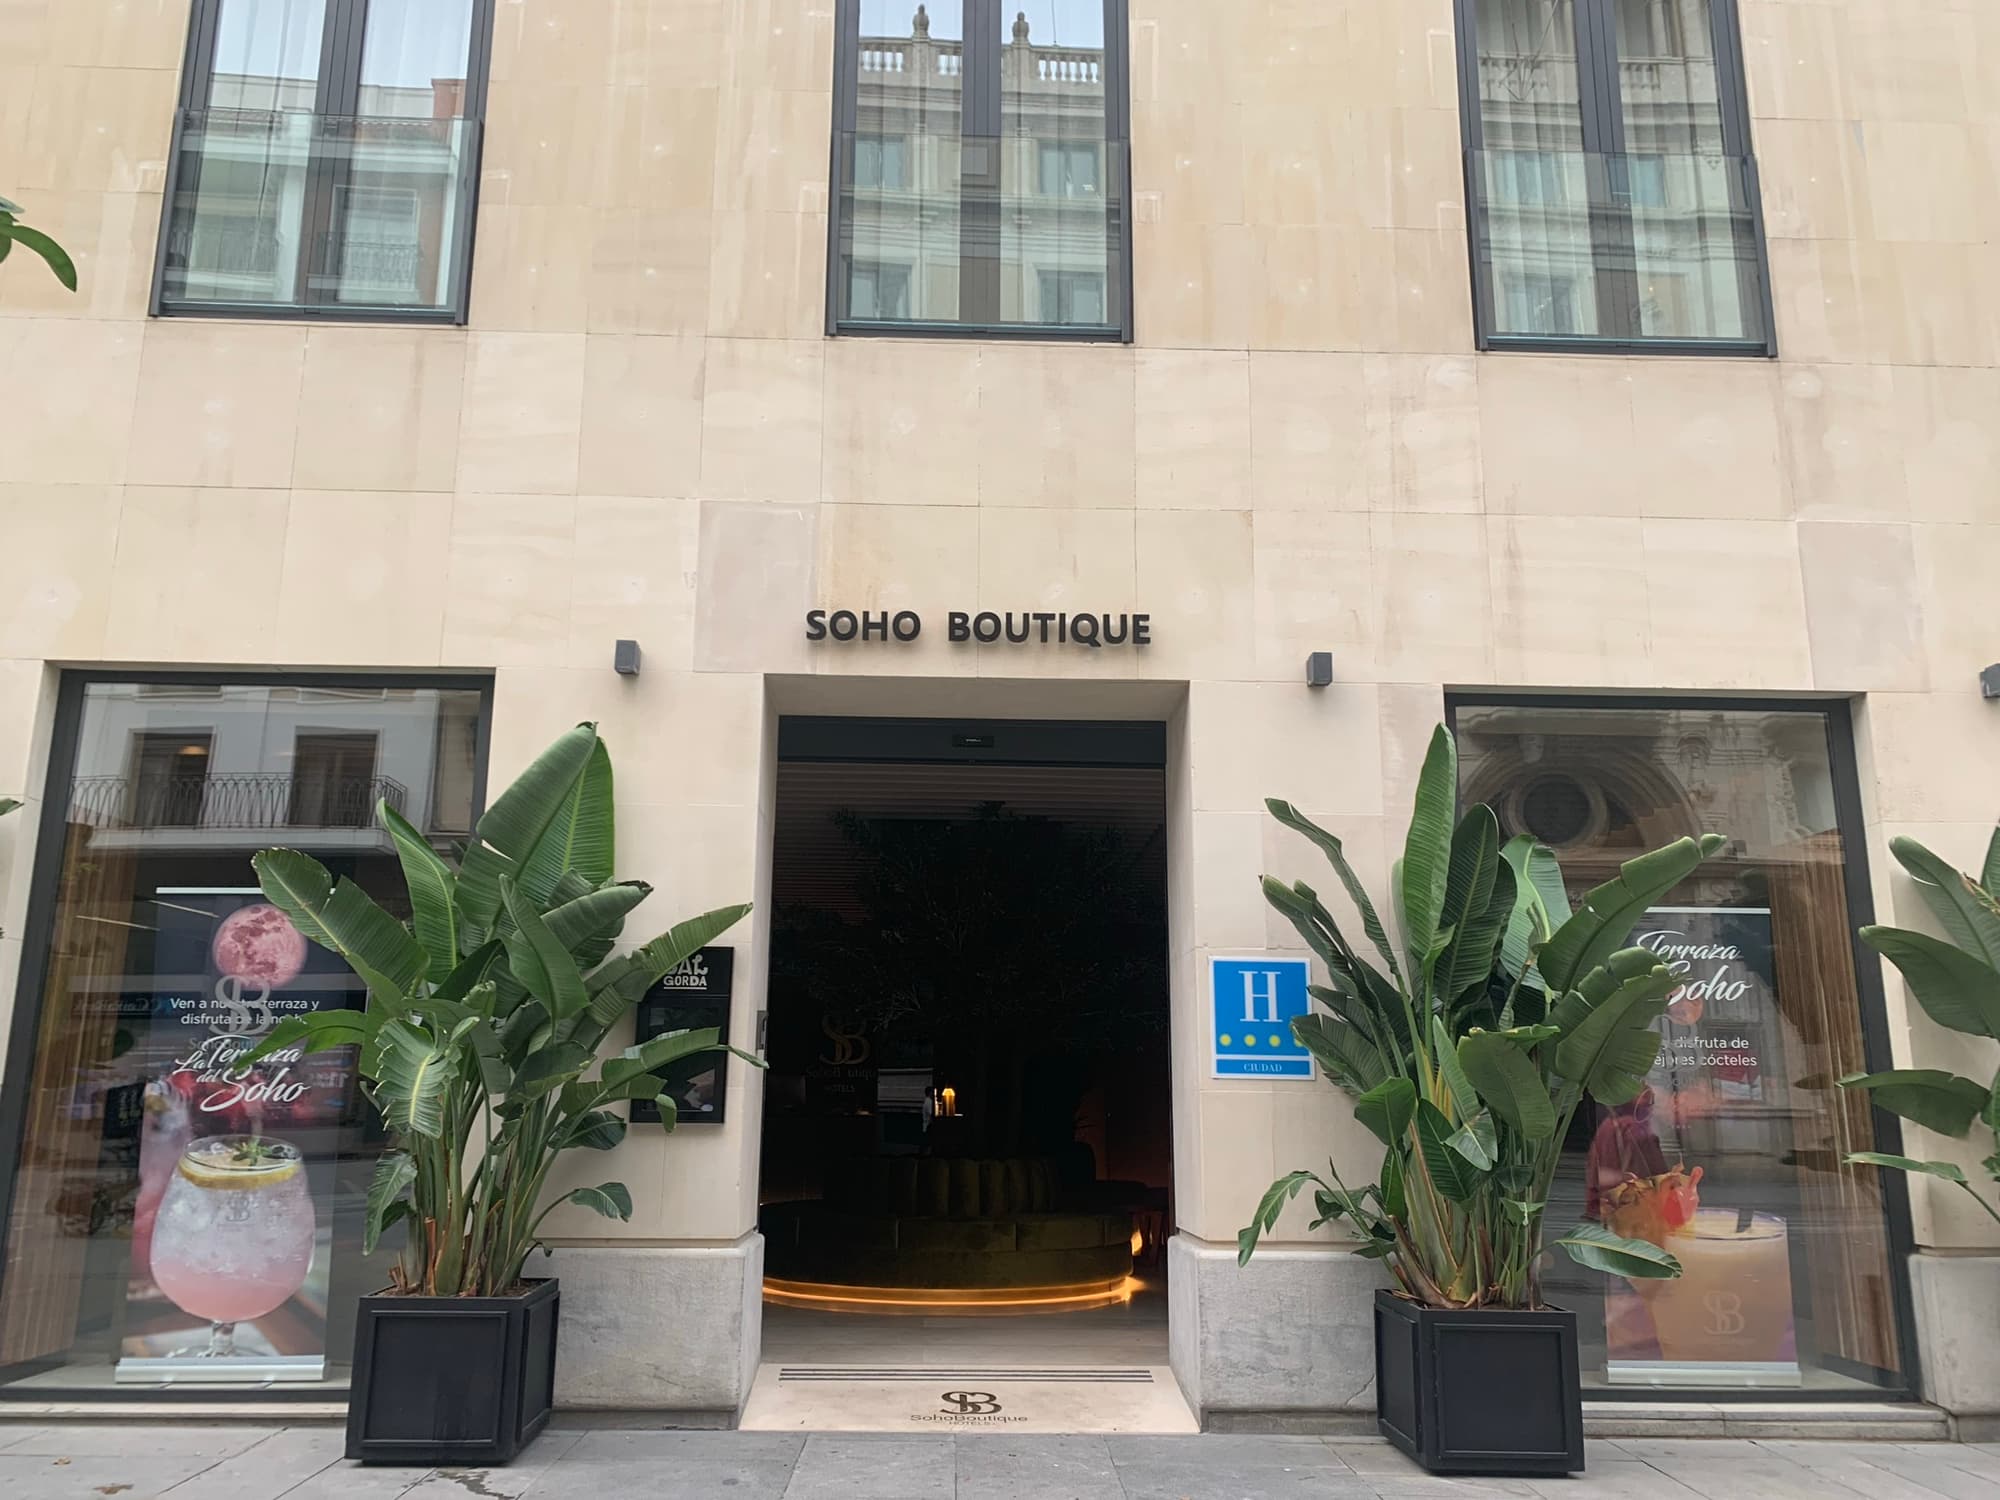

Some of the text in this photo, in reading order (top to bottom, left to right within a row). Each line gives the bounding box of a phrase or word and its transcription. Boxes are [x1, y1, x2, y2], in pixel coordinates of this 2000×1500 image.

[806, 610, 1152, 647] SOHO BOUTIQUE
[1637, 930, 1743, 960] Terraza
[667, 954, 709, 975] AL
[663, 975, 708, 986] GORDA
[1238, 970, 1284, 1023] H
[170, 998, 195, 1009] Ven
[198, 1000, 207, 1009] a
[311, 1000, 320, 1011] y
[180, 1013, 231, 1025] disfruta
[1674, 1036, 1727, 1049] disfruta
[1731, 1036, 1750, 1049] de
[172, 1050, 207, 1076] La
[1700, 1053, 1758, 1067] cócteles
[1243, 1062, 1283, 1073] CIUDAD
[196, 1068, 220, 1083] del
[200, 1066, 311, 1112] Soho
[910, 1414, 1029, 1423] SohoBoutique
